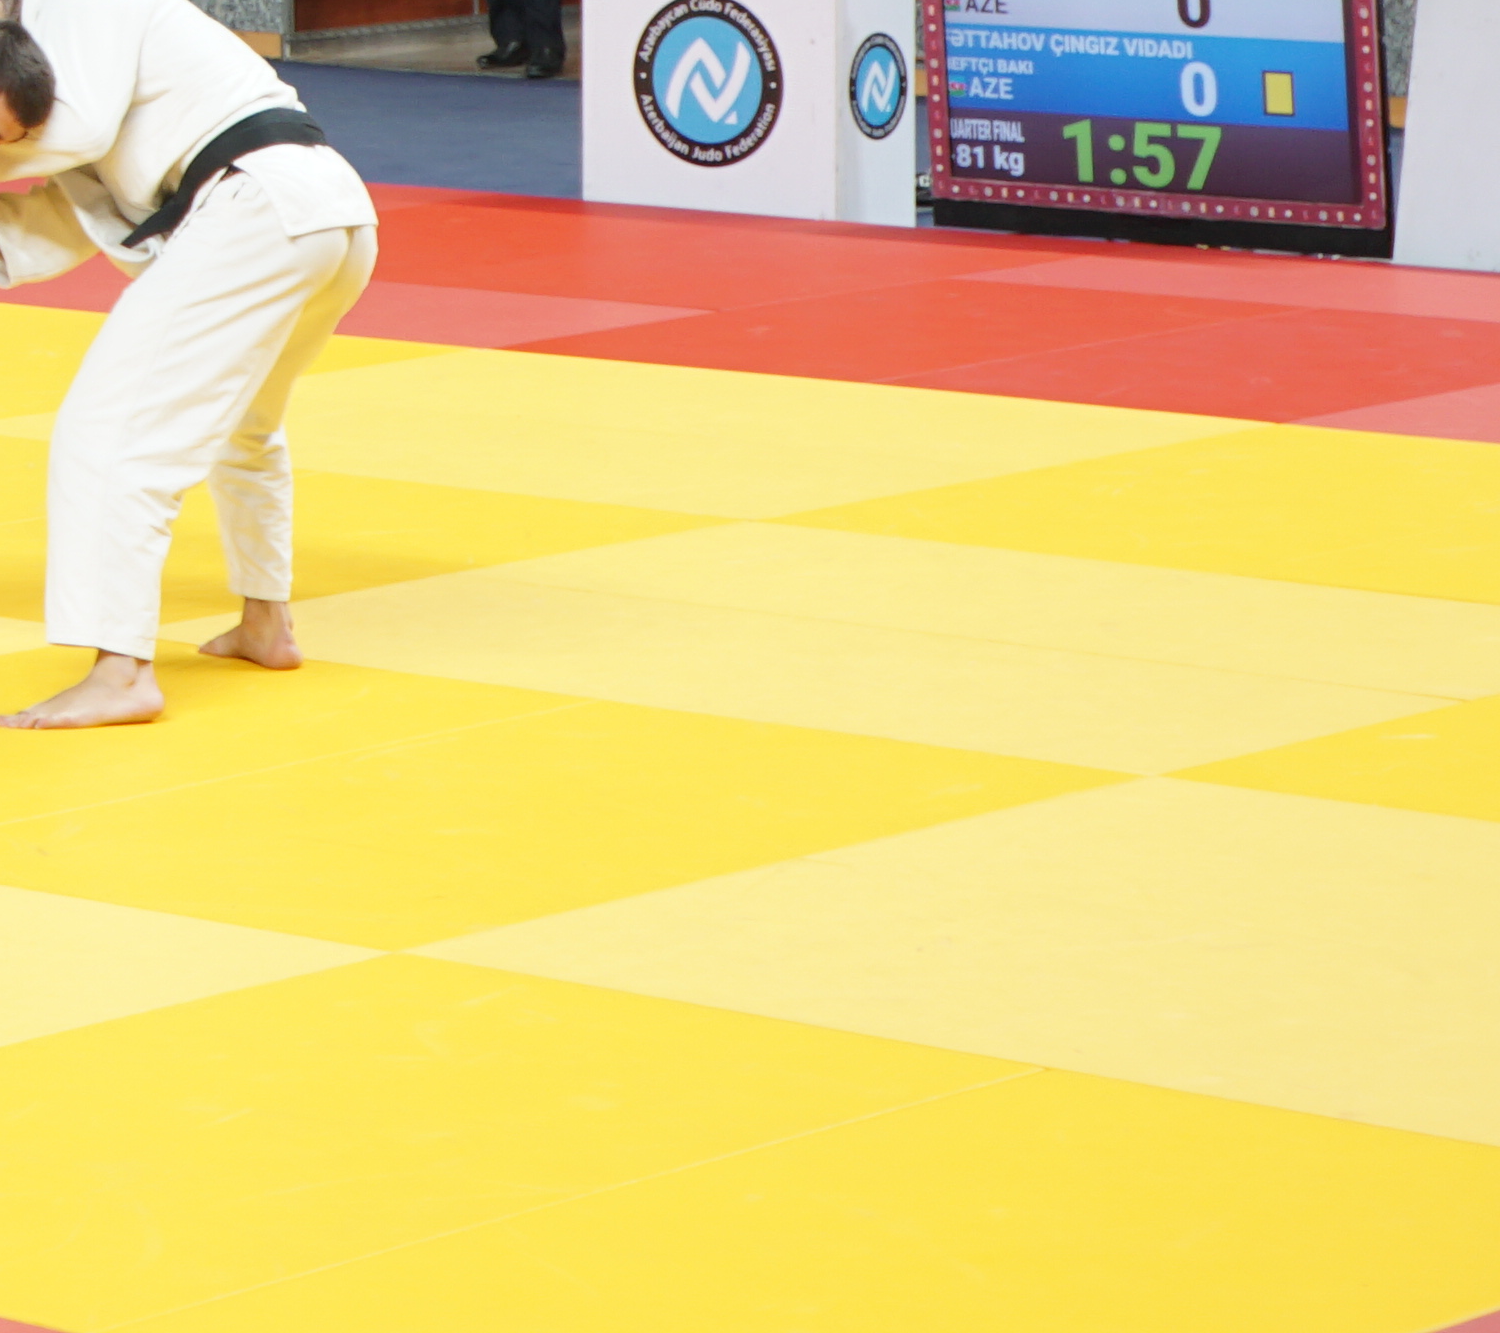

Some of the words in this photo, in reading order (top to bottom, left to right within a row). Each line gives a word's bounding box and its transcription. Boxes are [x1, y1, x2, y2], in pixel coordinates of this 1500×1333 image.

[1050, 34, 1120, 57] ÇINGIZ
[1123, 39, 1194, 60] VIDADI
[997, 58, 1035, 75] BAKI
[968, 77, 1014, 100] AZE
[1179, 61, 1218, 117] 0
[691, 146, 724, 162] Judo
[724, 102, 776, 159] Federation
[993, 145, 1025, 178] kg
[1062, 118, 1223, 191] 1:57
